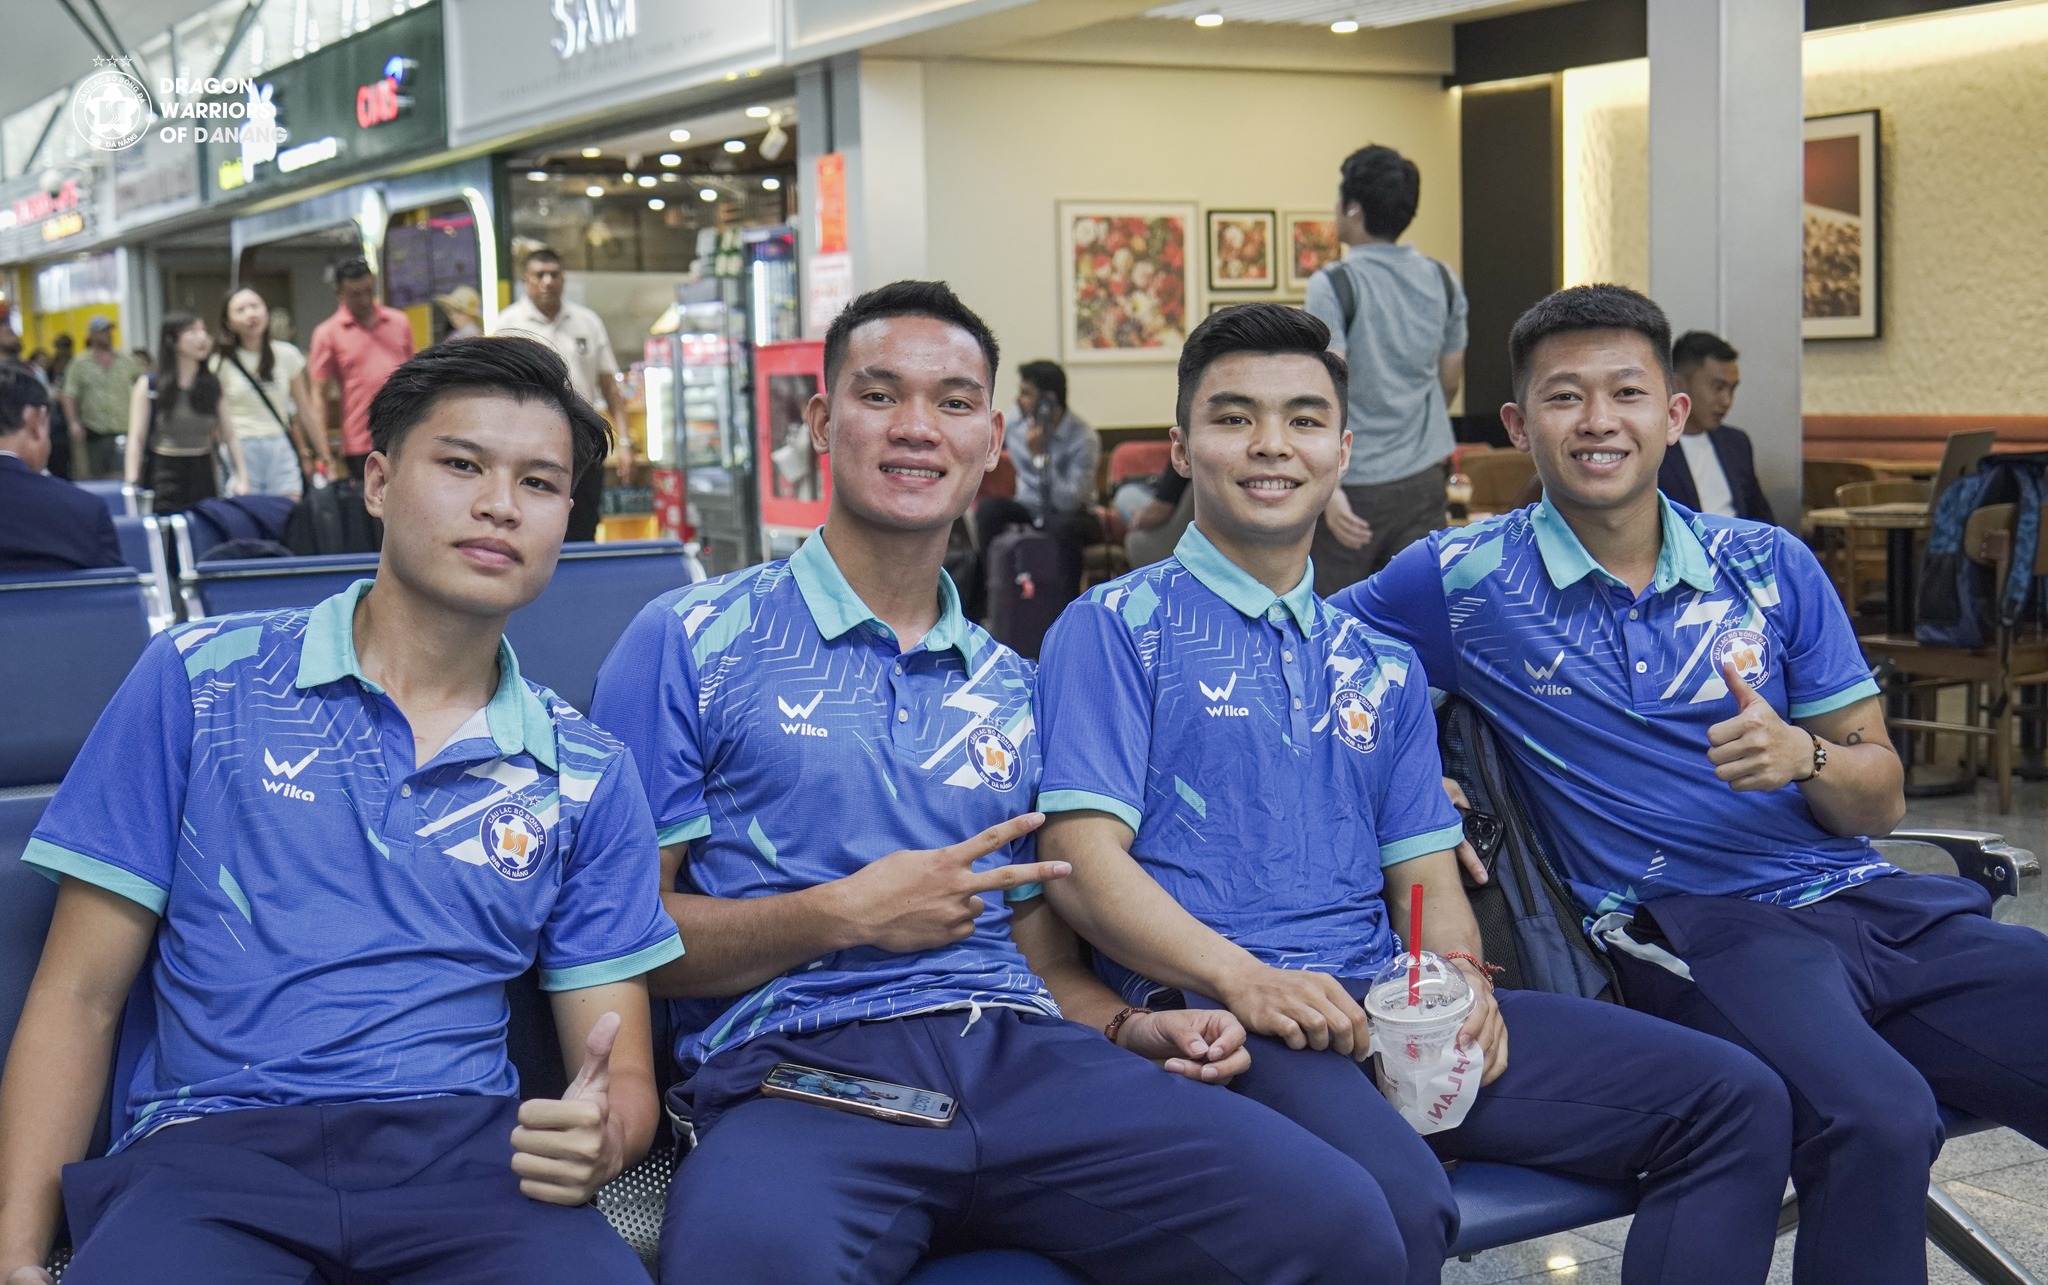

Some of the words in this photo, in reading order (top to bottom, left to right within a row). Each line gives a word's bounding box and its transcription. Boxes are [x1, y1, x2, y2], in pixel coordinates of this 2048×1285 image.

[1529, 684, 1572, 696] Wika
[1205, 704, 1249, 718] Wika
[780, 722, 828, 738] Wika
[262, 778, 315, 802] Wika
